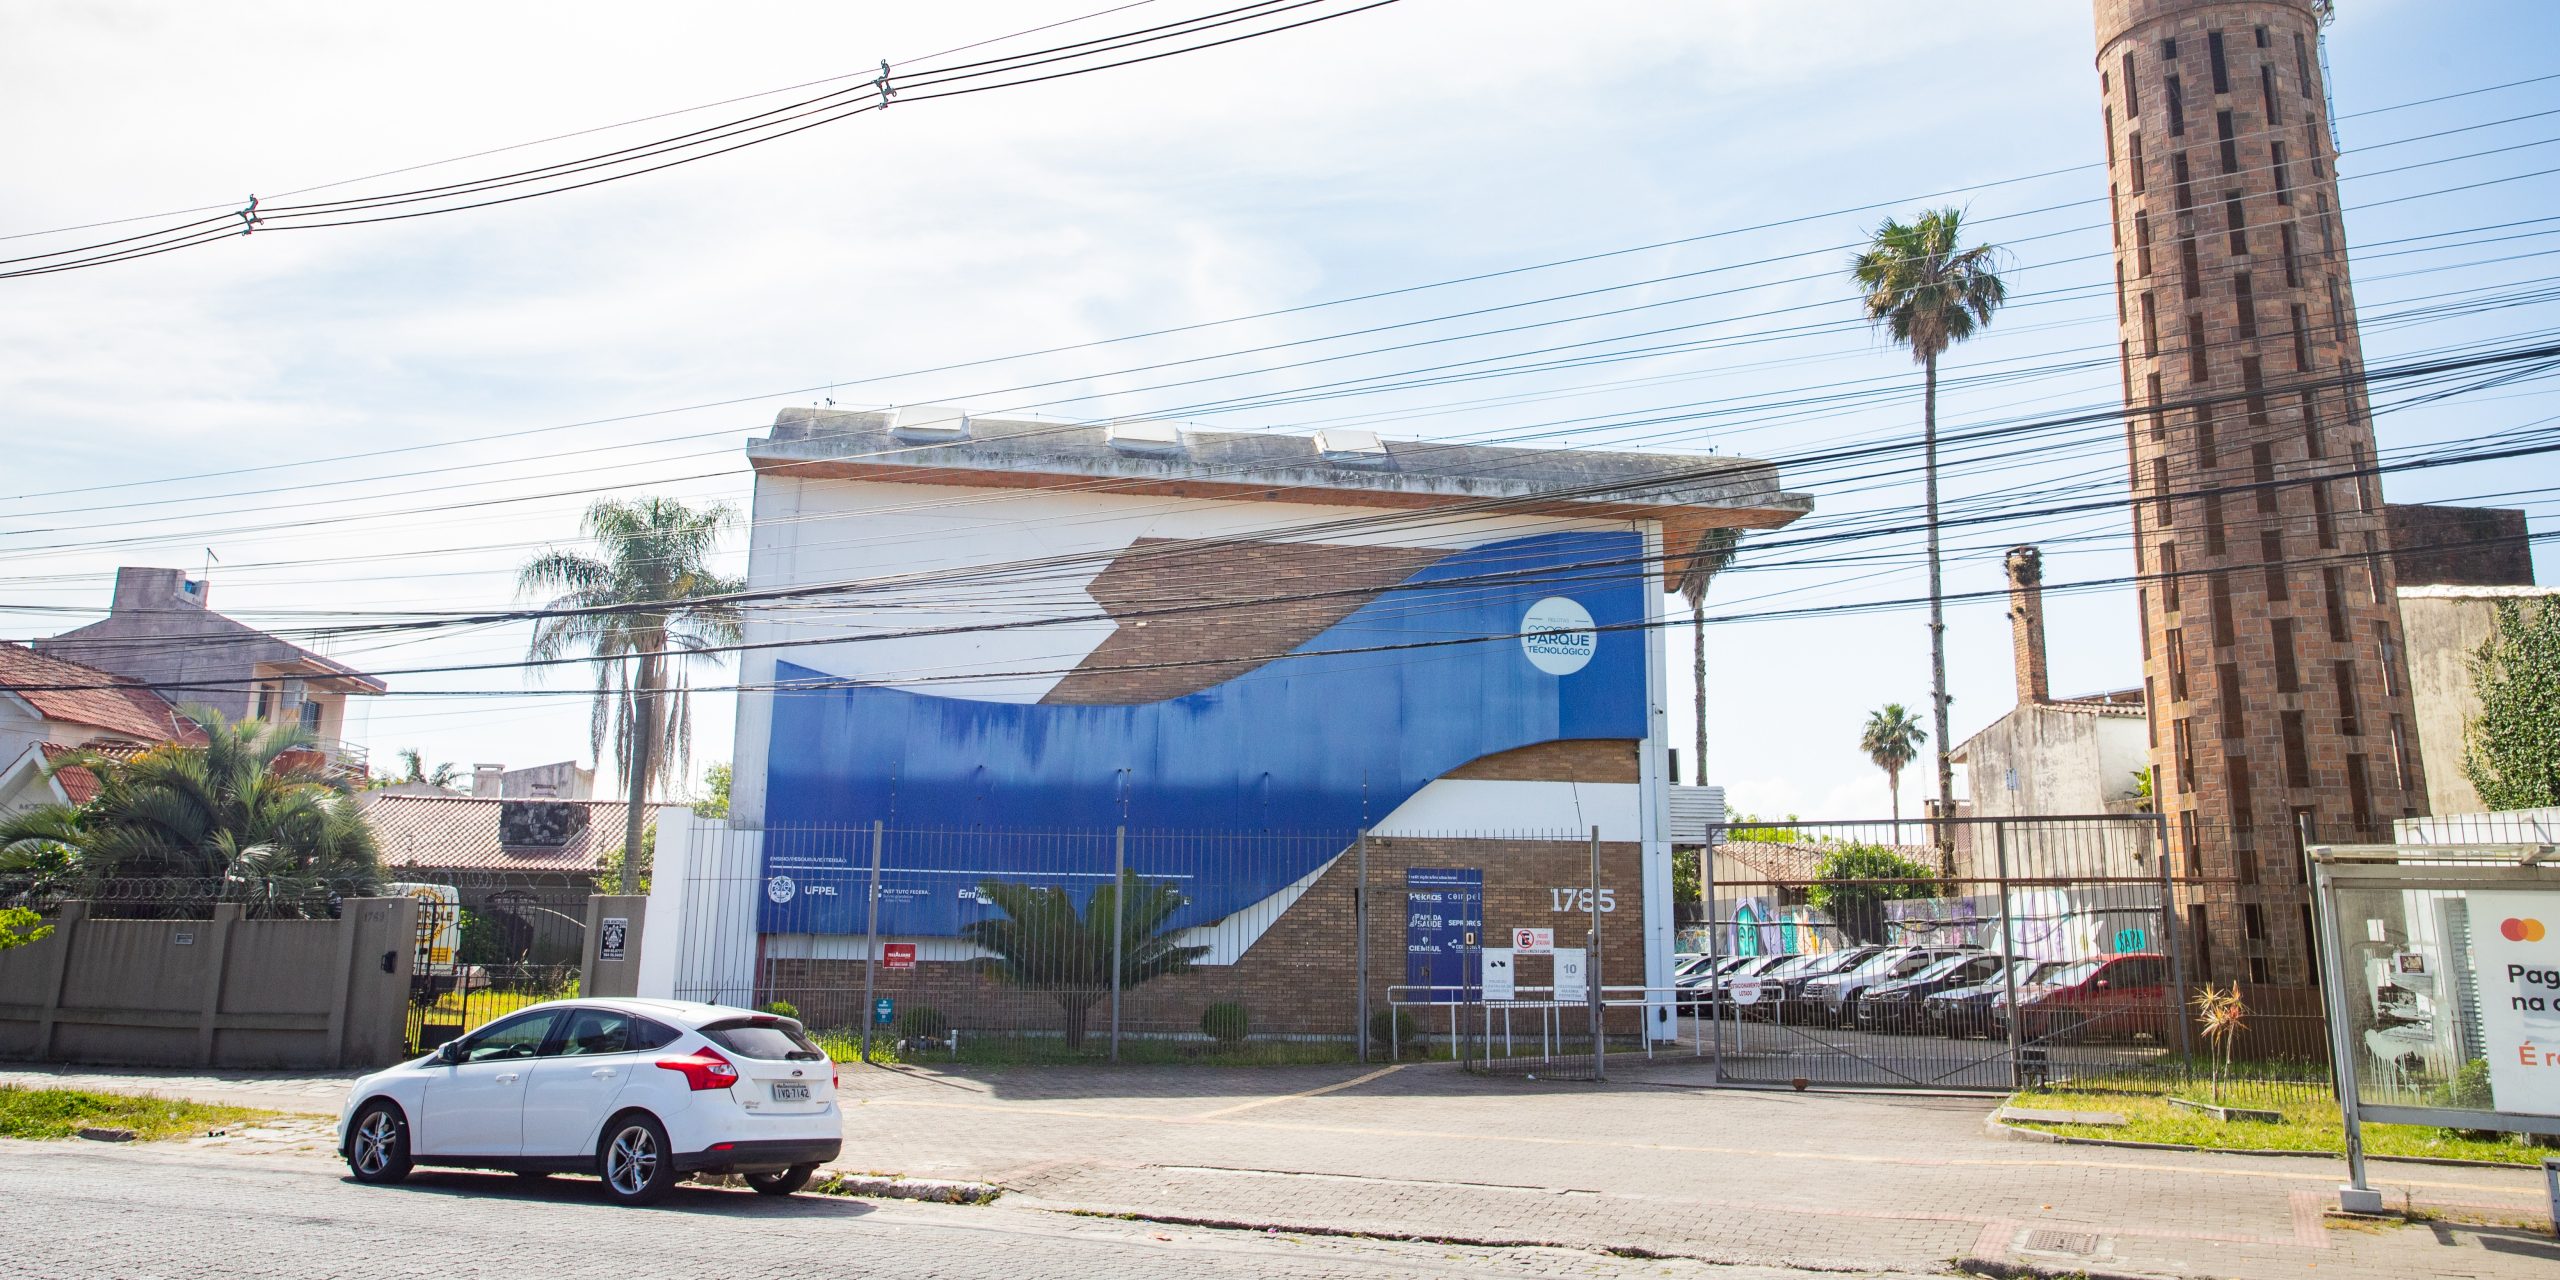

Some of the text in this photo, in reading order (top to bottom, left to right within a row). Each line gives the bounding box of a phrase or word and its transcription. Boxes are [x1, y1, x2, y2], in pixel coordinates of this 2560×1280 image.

[1527, 632, 1590, 646] PARQUE
[1528, 645, 1591, 656] TECNOLÓGICO
[804, 885, 838, 896] UFPEL
[1550, 888, 1616, 913] 1785
[1564, 963, 1577, 974] 10
[2511, 996, 2545, 1011] na
[2519, 1041, 2538, 1066] É
